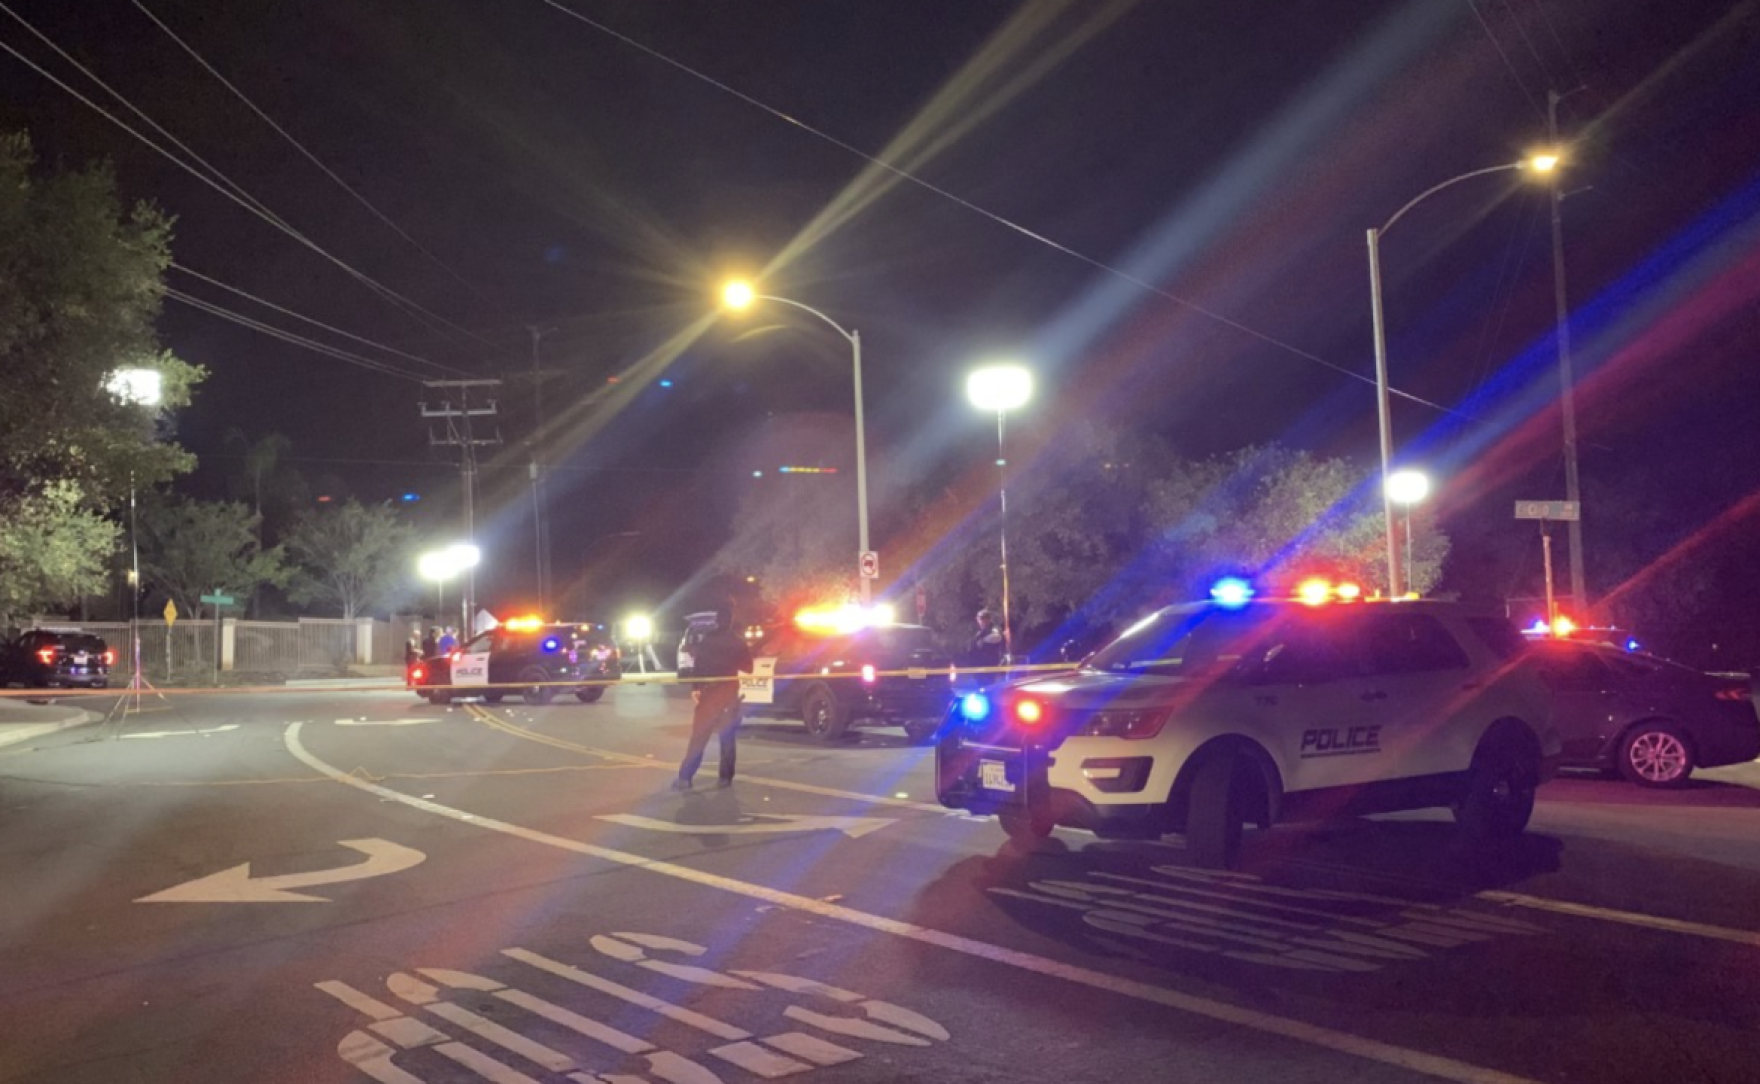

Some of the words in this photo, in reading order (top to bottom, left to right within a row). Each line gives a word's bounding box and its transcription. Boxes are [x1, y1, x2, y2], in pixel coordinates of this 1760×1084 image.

[455, 667, 484, 676] POLICE
[742, 677, 769, 687] POLICE
[1300, 724, 1382, 752] POLICE
